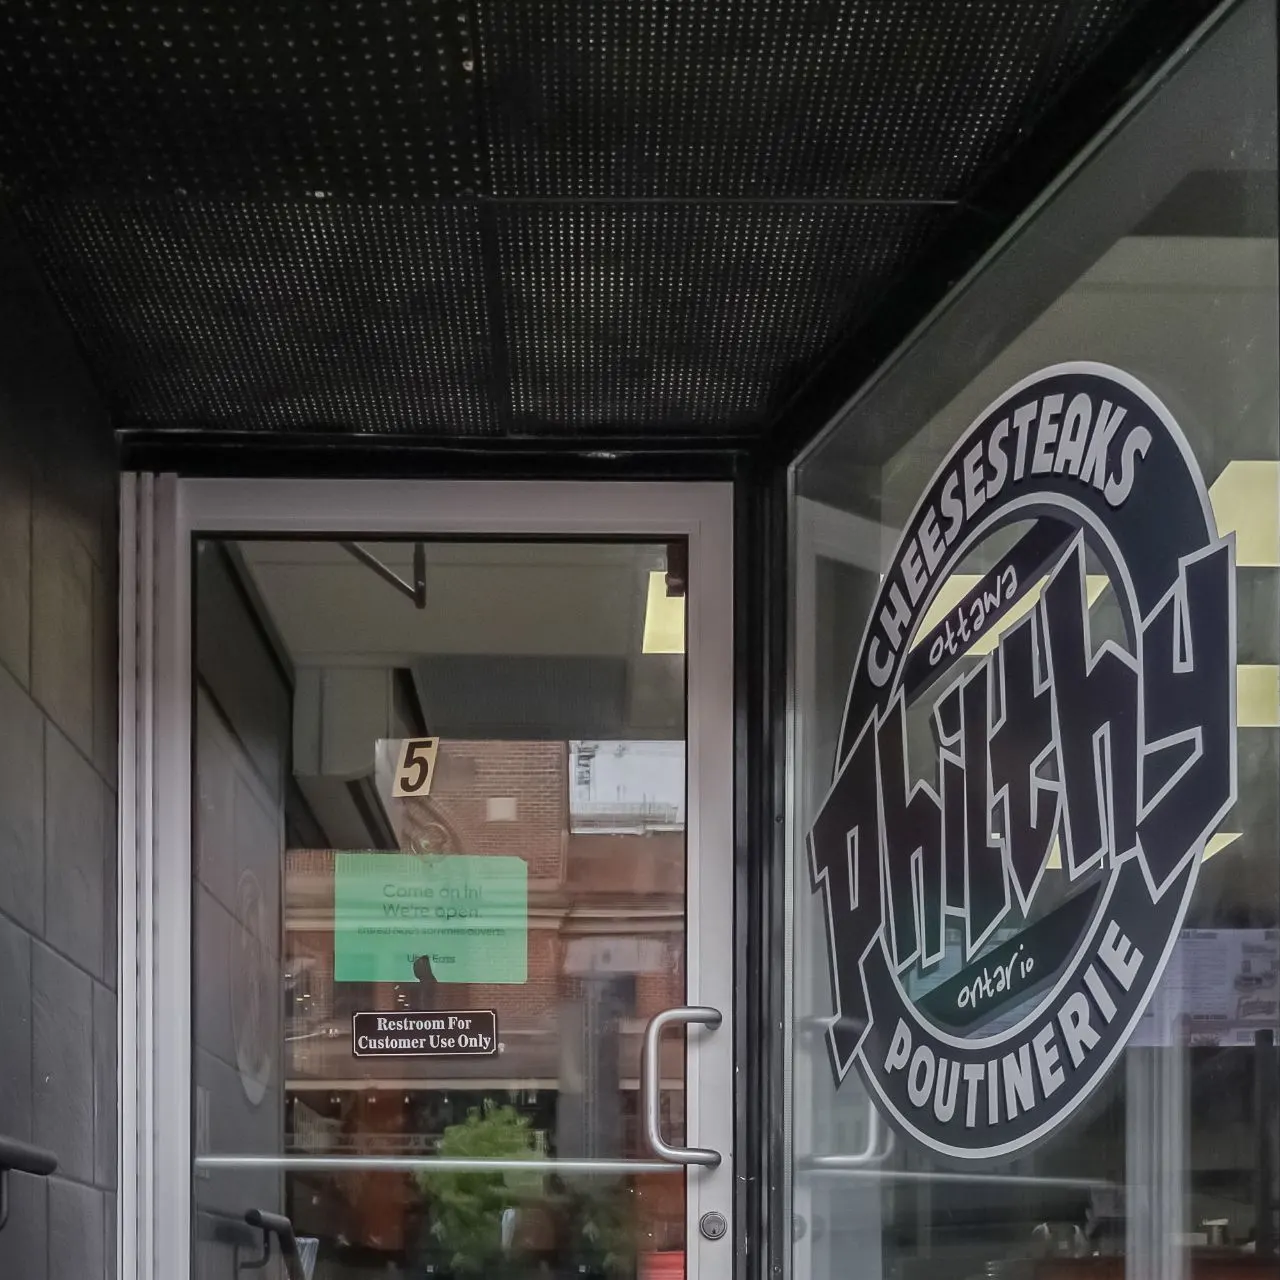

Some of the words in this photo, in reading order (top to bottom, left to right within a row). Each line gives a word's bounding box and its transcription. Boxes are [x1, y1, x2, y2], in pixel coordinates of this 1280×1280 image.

[867, 393, 1152, 688] CHEESESTEAKS
[400, 741, 433, 792] 5
[358, 1035, 426, 1049] Customer
[429, 1035, 455, 1048] Use
[458, 1034, 491, 1049] Only
[377, 1017, 445, 1031] Restroom
[448, 1016, 472, 1030] For
[885, 920, 1144, 1129] POUTINERIE
